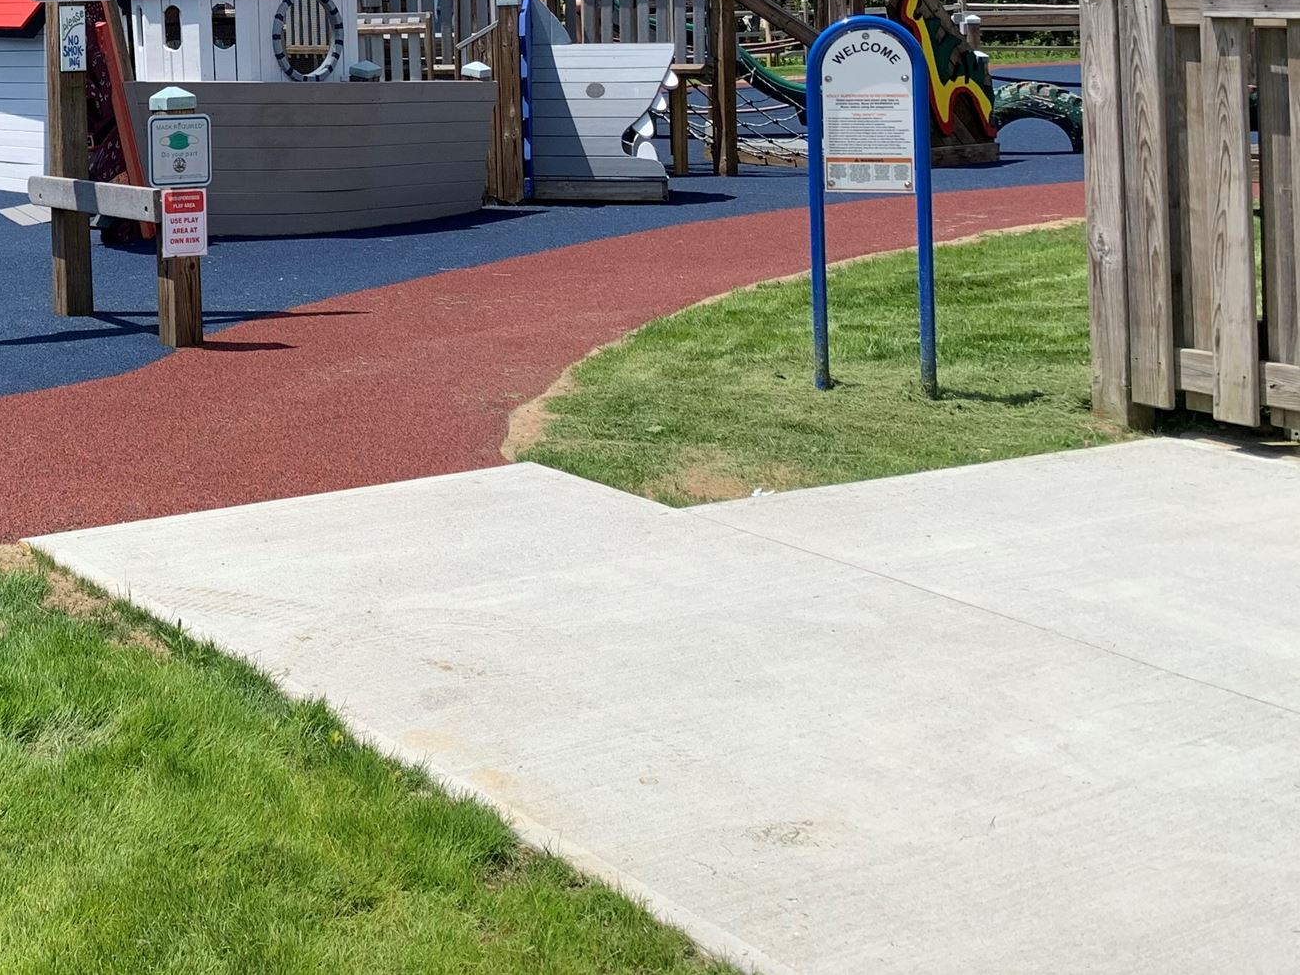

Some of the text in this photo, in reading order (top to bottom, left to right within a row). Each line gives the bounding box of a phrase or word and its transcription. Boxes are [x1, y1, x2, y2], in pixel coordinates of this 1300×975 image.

[67, 35, 80, 46] NO
[62, 45, 85, 58] SMOK-
[831, 41, 901, 66] WELCOME
[69, 56, 80, 68] ING
